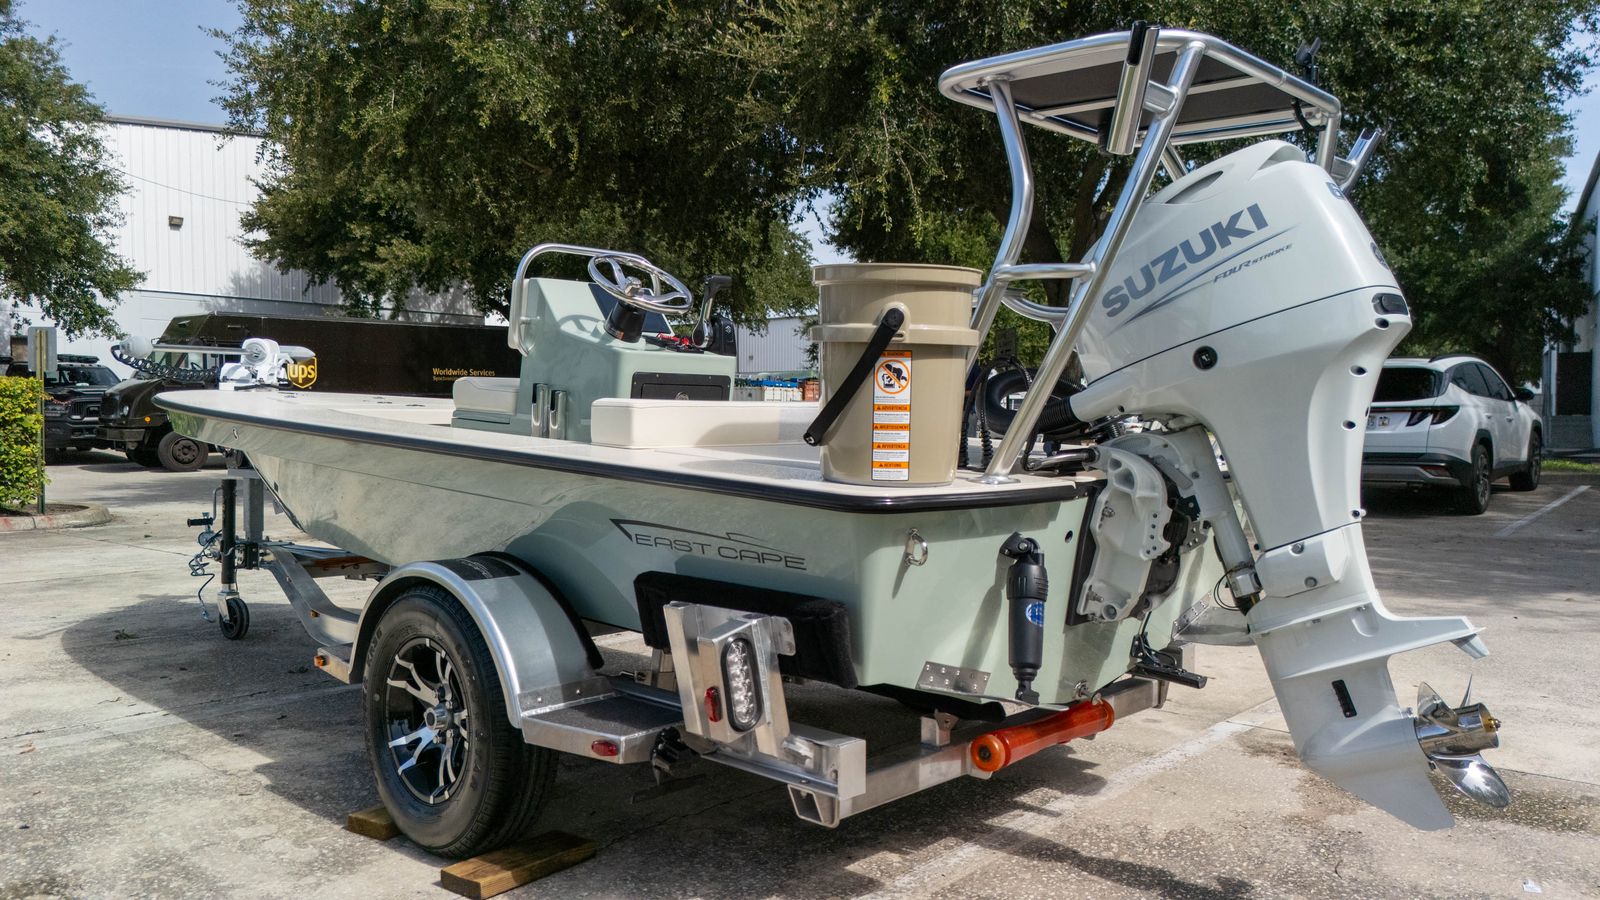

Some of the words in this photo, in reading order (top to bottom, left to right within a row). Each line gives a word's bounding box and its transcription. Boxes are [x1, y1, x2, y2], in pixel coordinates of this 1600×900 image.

[1101, 203, 1269, 318] SUZUKI
[289, 364, 315, 383] ups
[432, 367, 468, 376] Worldwide
[469, 368, 496, 377] Services
[635, 534, 712, 555] EAST
[717, 546, 807, 571] CAPE
